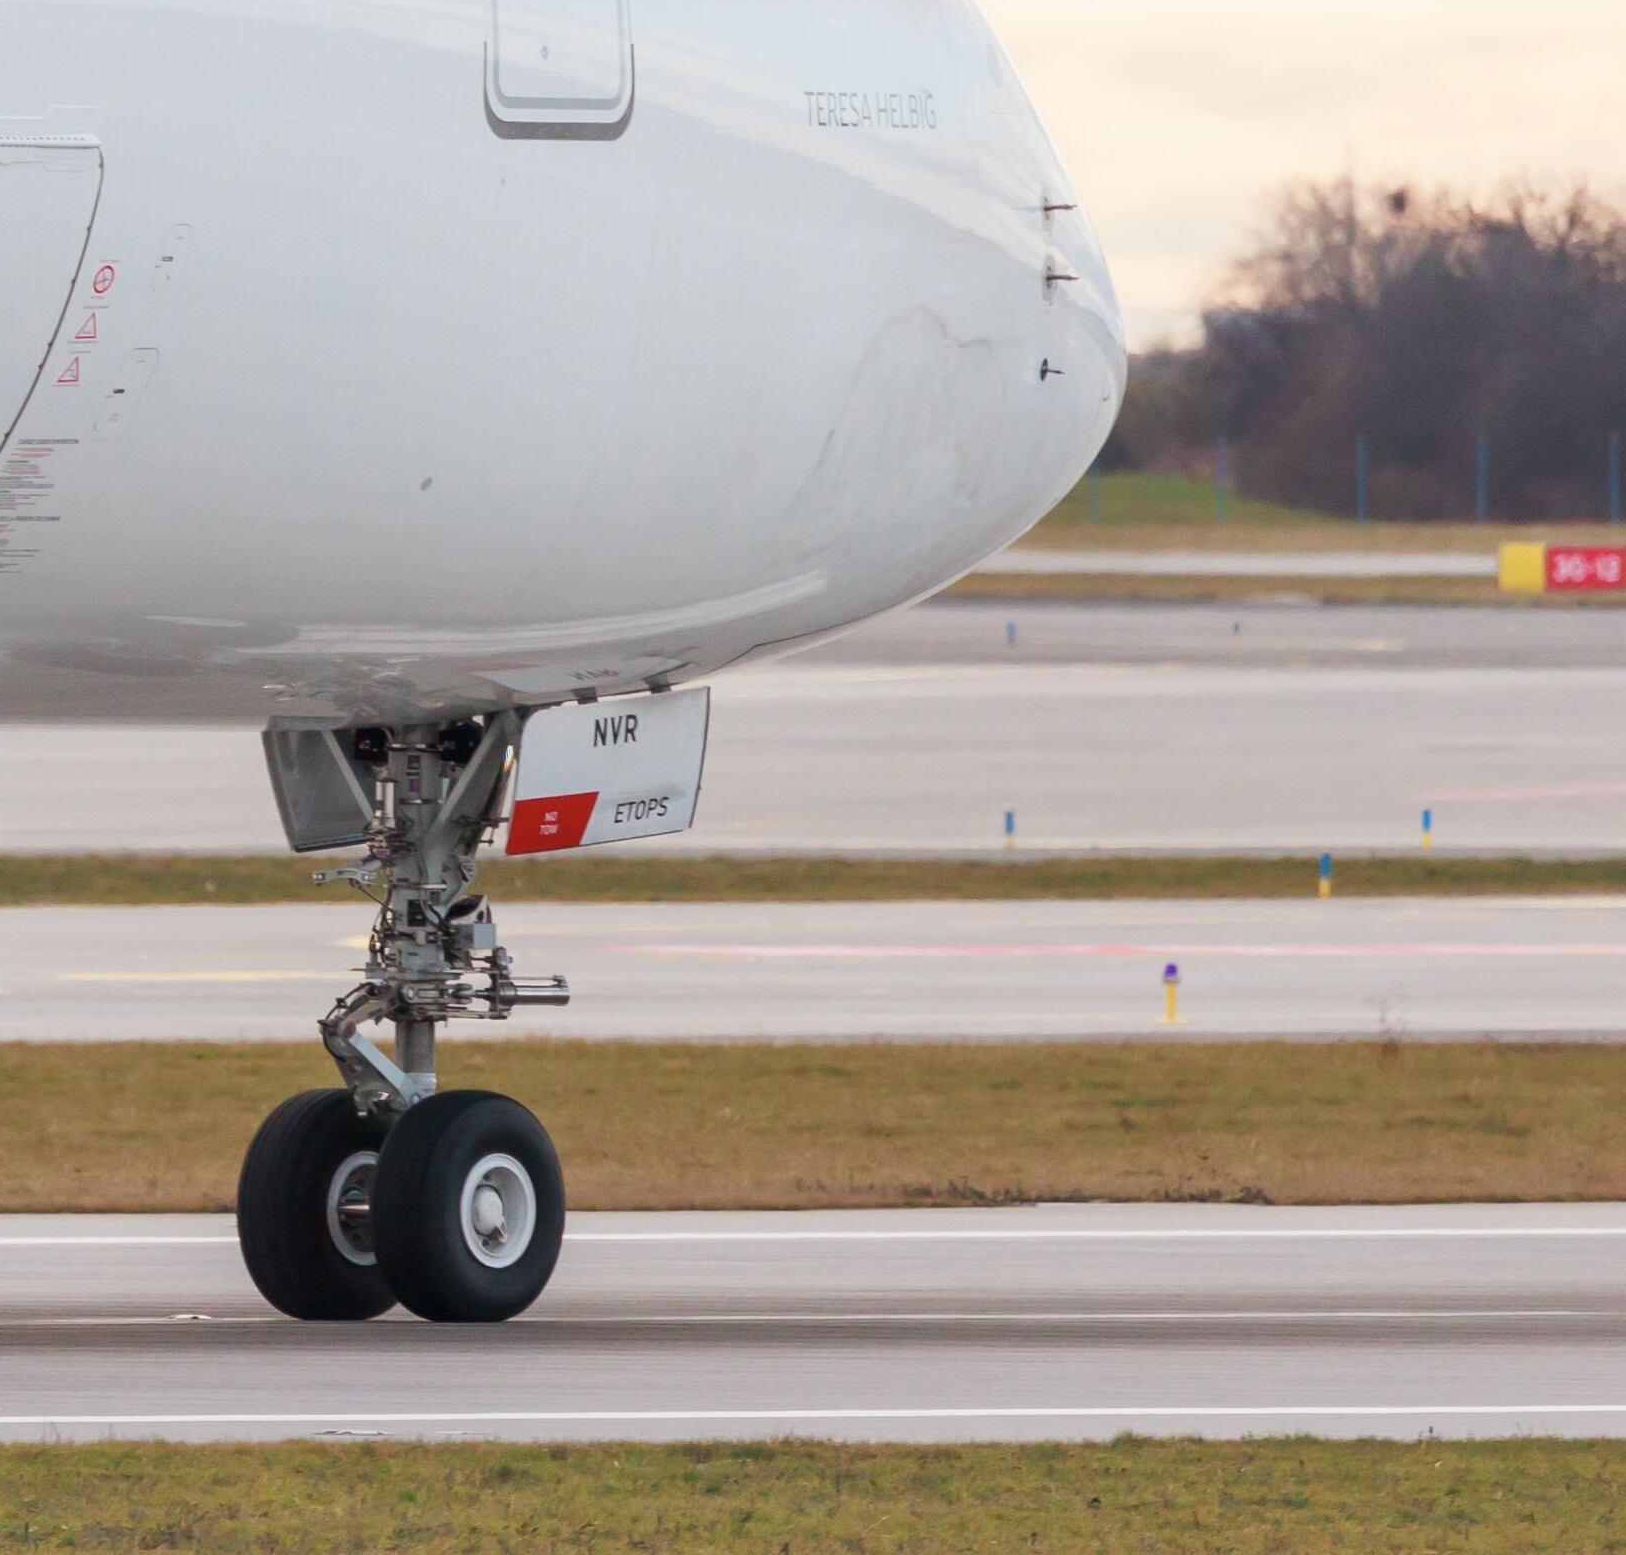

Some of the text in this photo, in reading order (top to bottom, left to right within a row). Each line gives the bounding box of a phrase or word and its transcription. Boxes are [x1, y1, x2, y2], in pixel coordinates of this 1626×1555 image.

[803, 91, 937, 130] TERESA HELBIG
[593, 713, 639, 747] NVR
[614, 796, 670, 824] ETOPS
